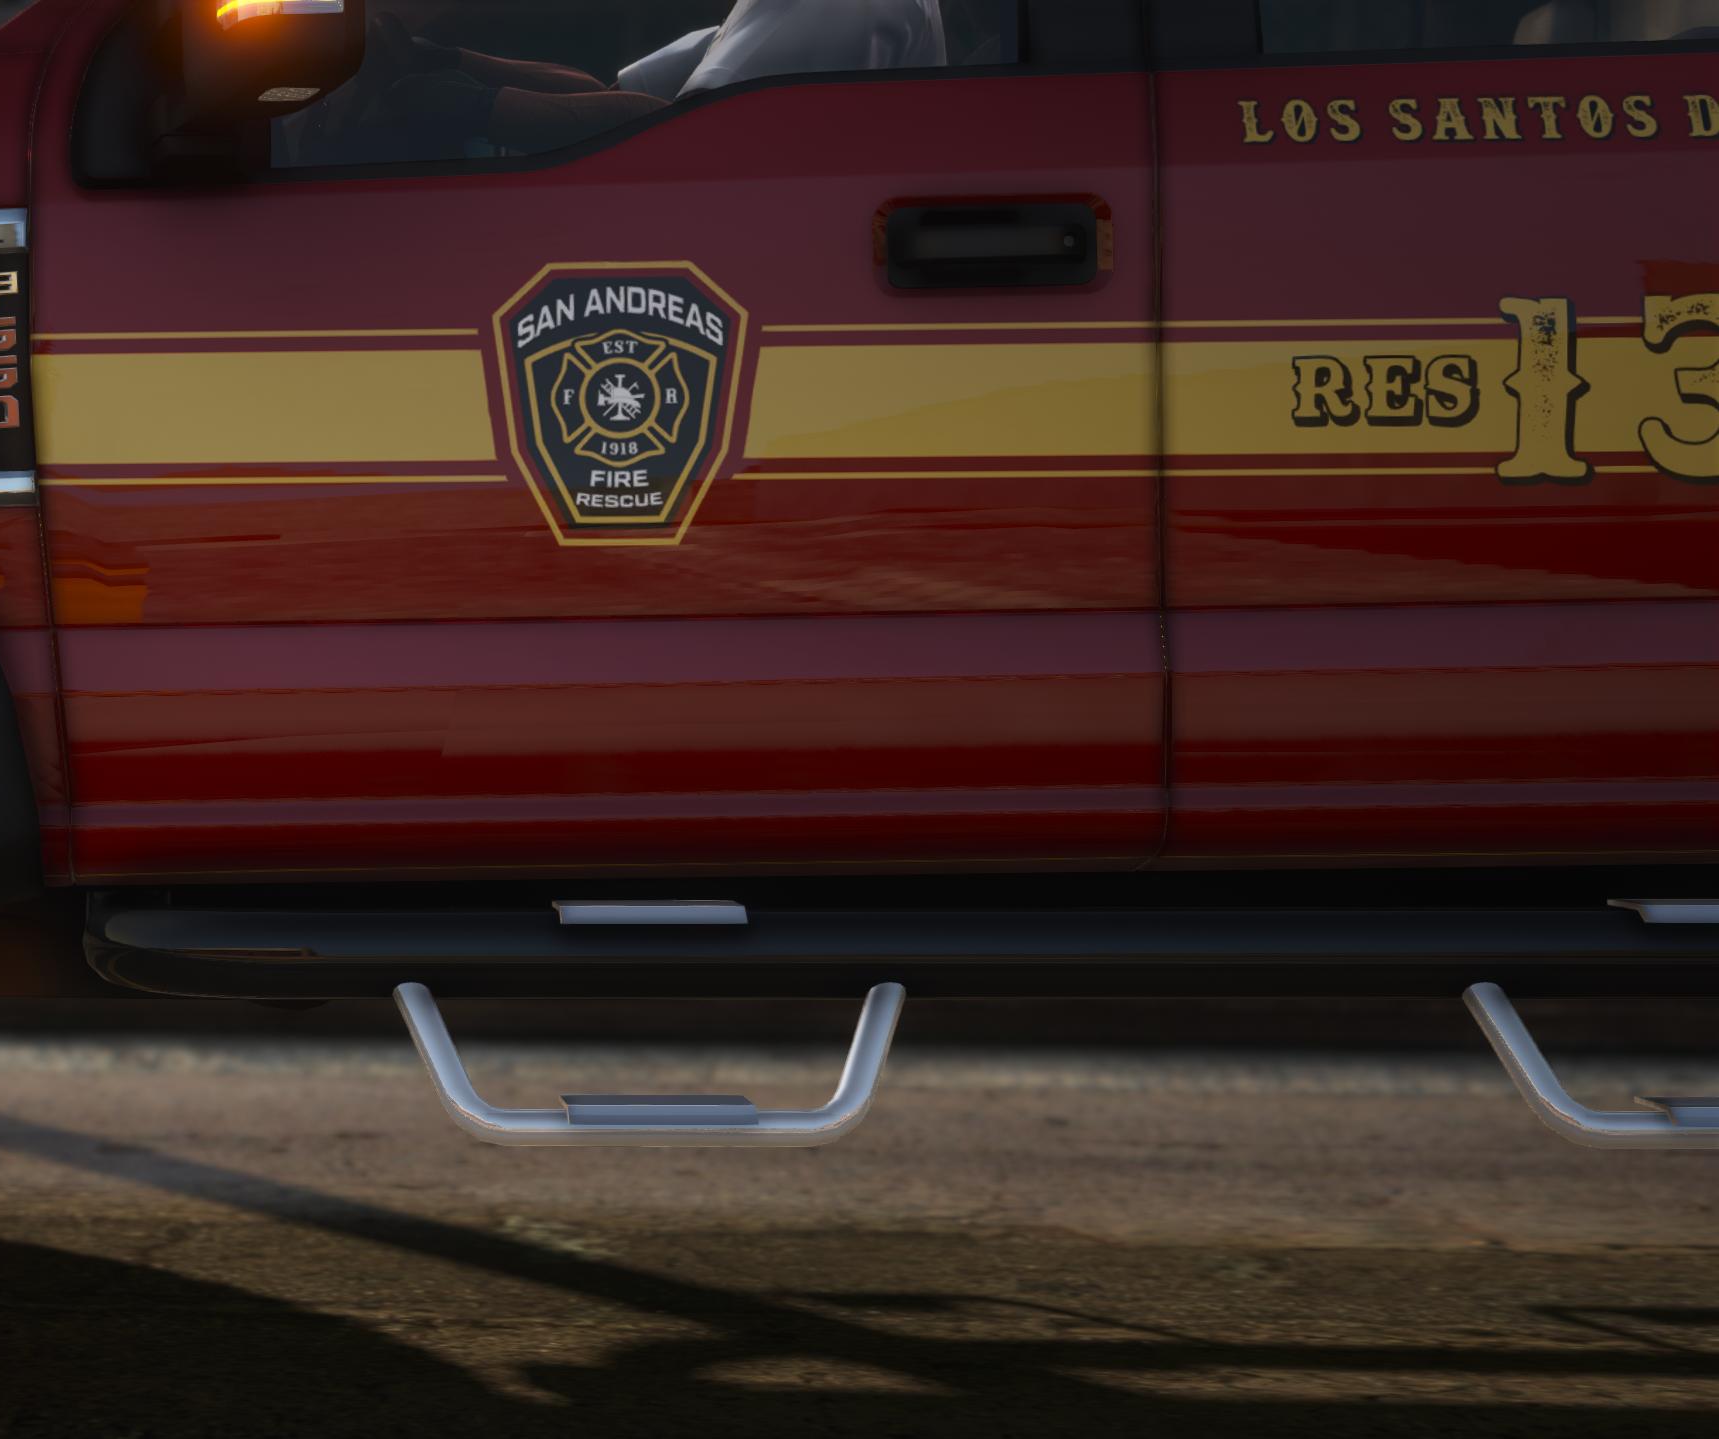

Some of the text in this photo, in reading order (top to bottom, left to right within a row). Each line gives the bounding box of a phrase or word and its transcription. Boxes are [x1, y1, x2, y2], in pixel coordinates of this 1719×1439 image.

[1238, 98, 1363, 144] LOS
[1388, 94, 1658, 141] SANTOS
[516, 285, 725, 349] SAN ANDREAS
[602, 340, 639, 355] EST
[563, 388, 575, 405] F
[665, 388, 679, 405] R
[1291, 354, 1481, 428] RES
[600, 441, 639, 456] 1918
[589, 468, 650, 488] FIRE
[575, 491, 664, 508] RESCUE
